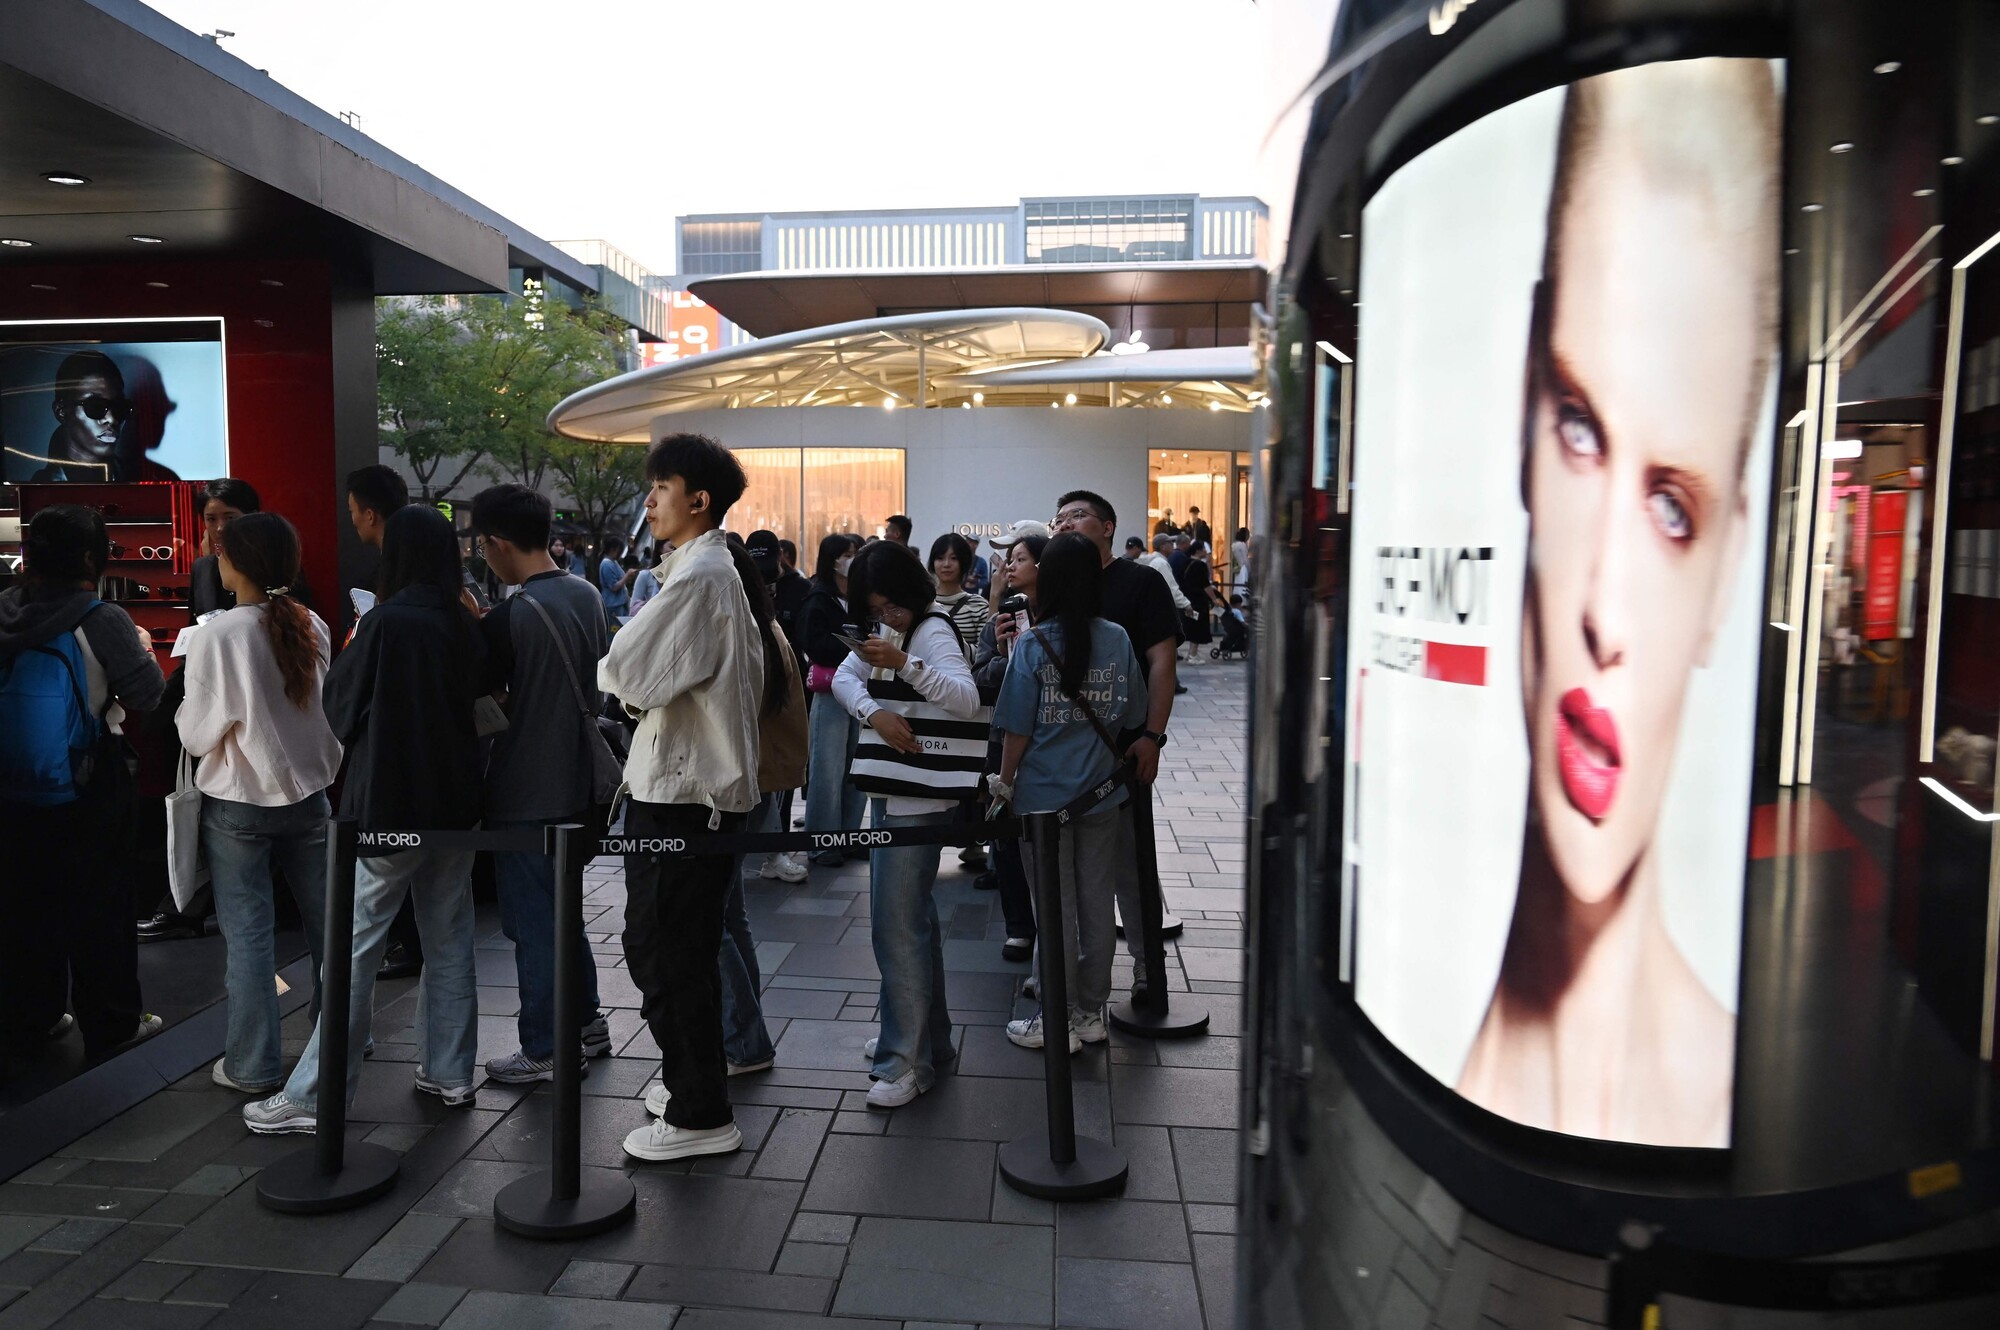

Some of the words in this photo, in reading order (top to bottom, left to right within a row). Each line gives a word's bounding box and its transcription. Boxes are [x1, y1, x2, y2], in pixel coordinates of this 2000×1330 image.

[917, 740, 948, 750] HORA
[1057, 809, 1070, 824] ORD
[377, 832, 421, 846] FORD
[598, 839, 636, 853] TOM
[639, 838, 686, 853] FORD
[811, 833, 846, 847] TOM
[849, 831, 892, 846] FORD
